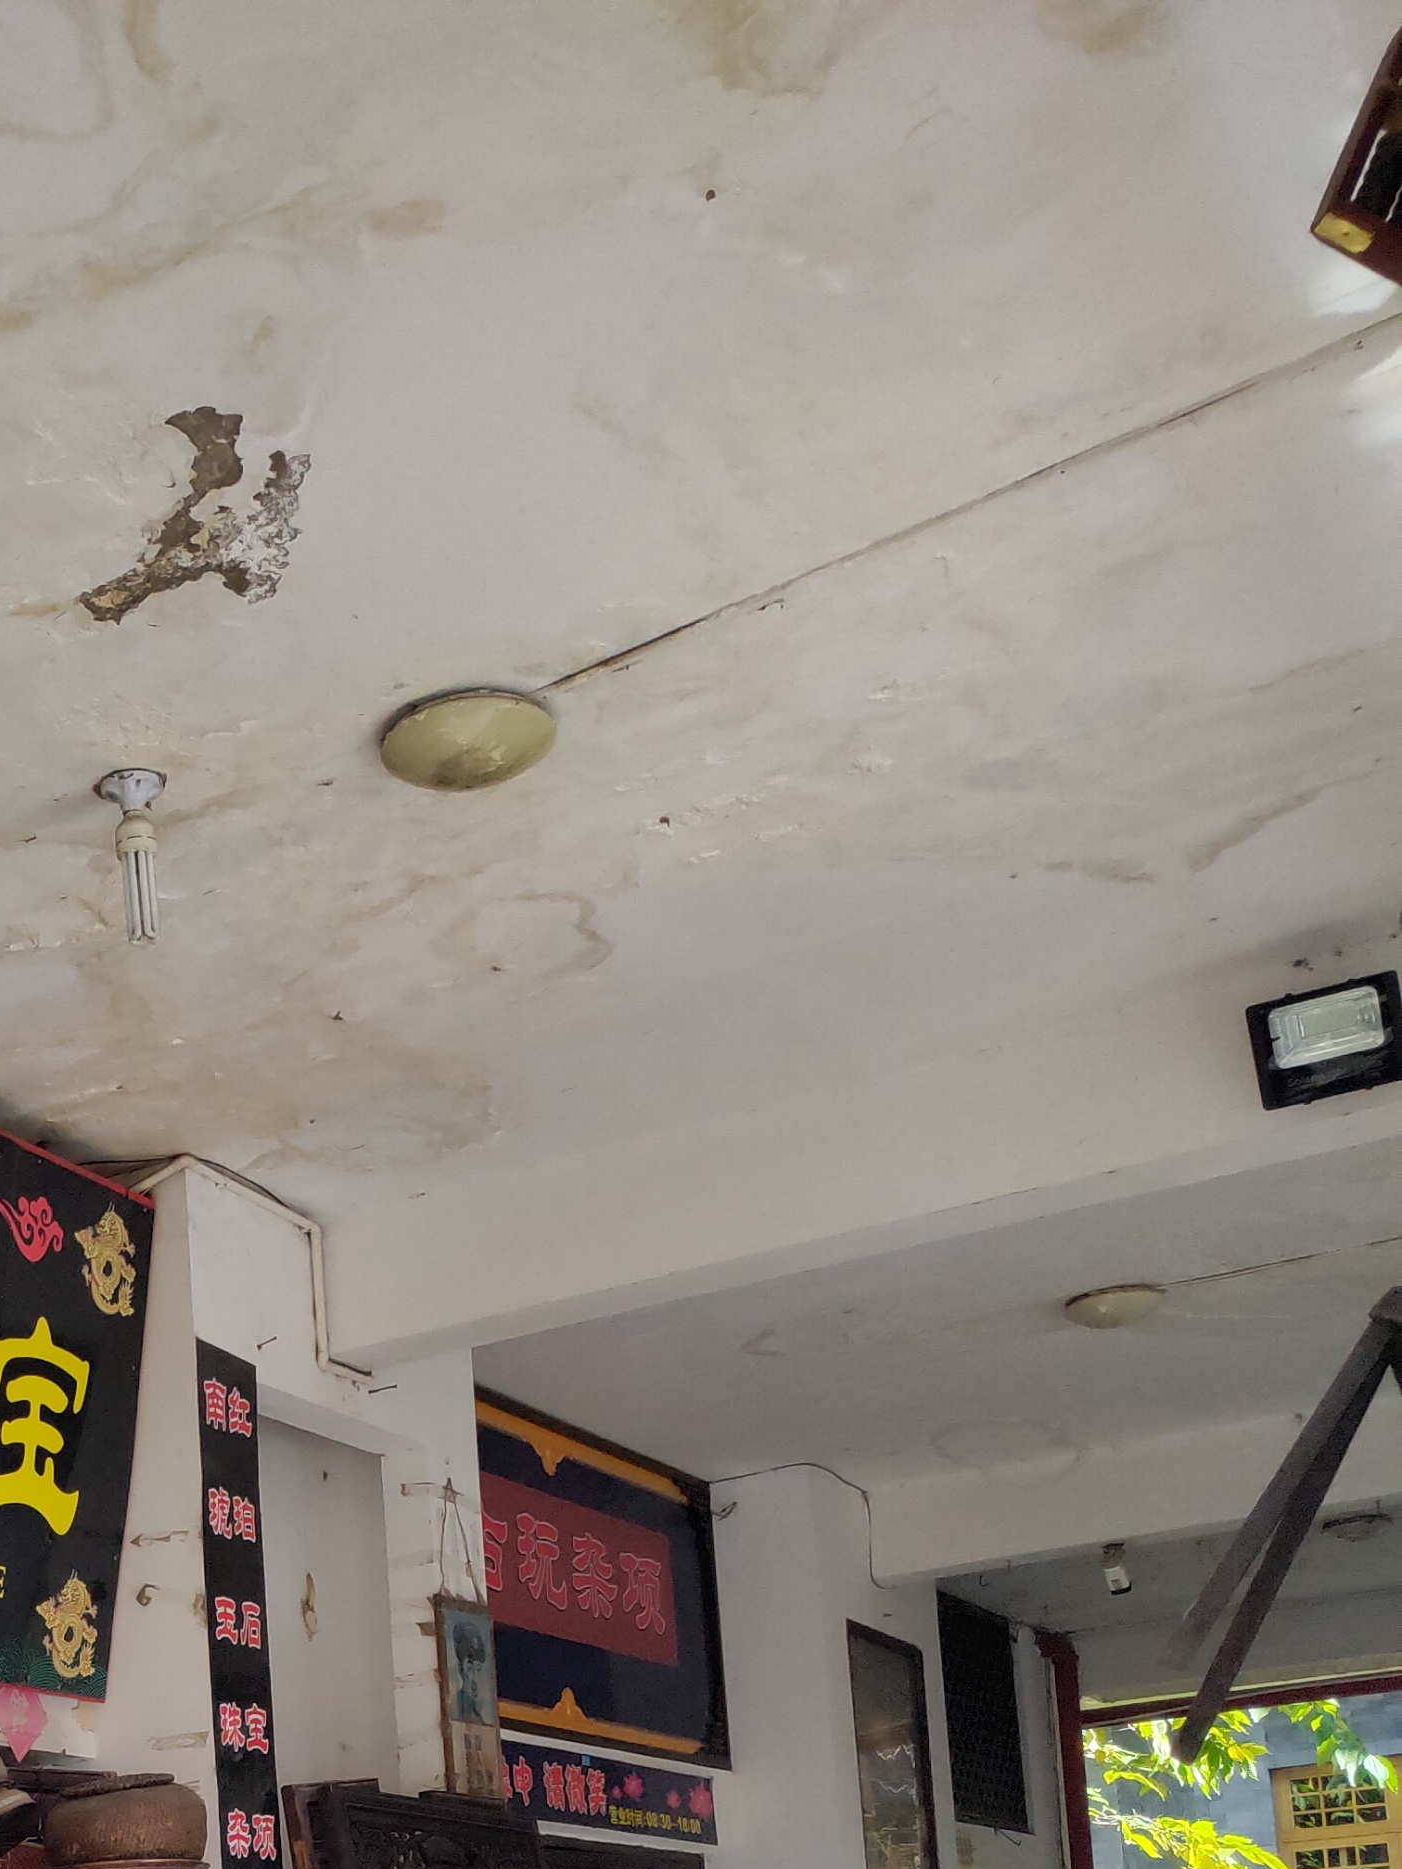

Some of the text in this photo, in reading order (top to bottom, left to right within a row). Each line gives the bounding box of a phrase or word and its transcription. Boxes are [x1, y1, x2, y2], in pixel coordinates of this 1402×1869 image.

[203, 1379, 253, 1437] 南红
[209, 1487, 257, 1543] 琥珀
[213, 1595, 263, 1651] 玉石
[219, 1703, 270, 1755] 珠宝
[542, 1761, 608, 1817] 请微笑
[226, 1808, 278, 1860] 杂项
